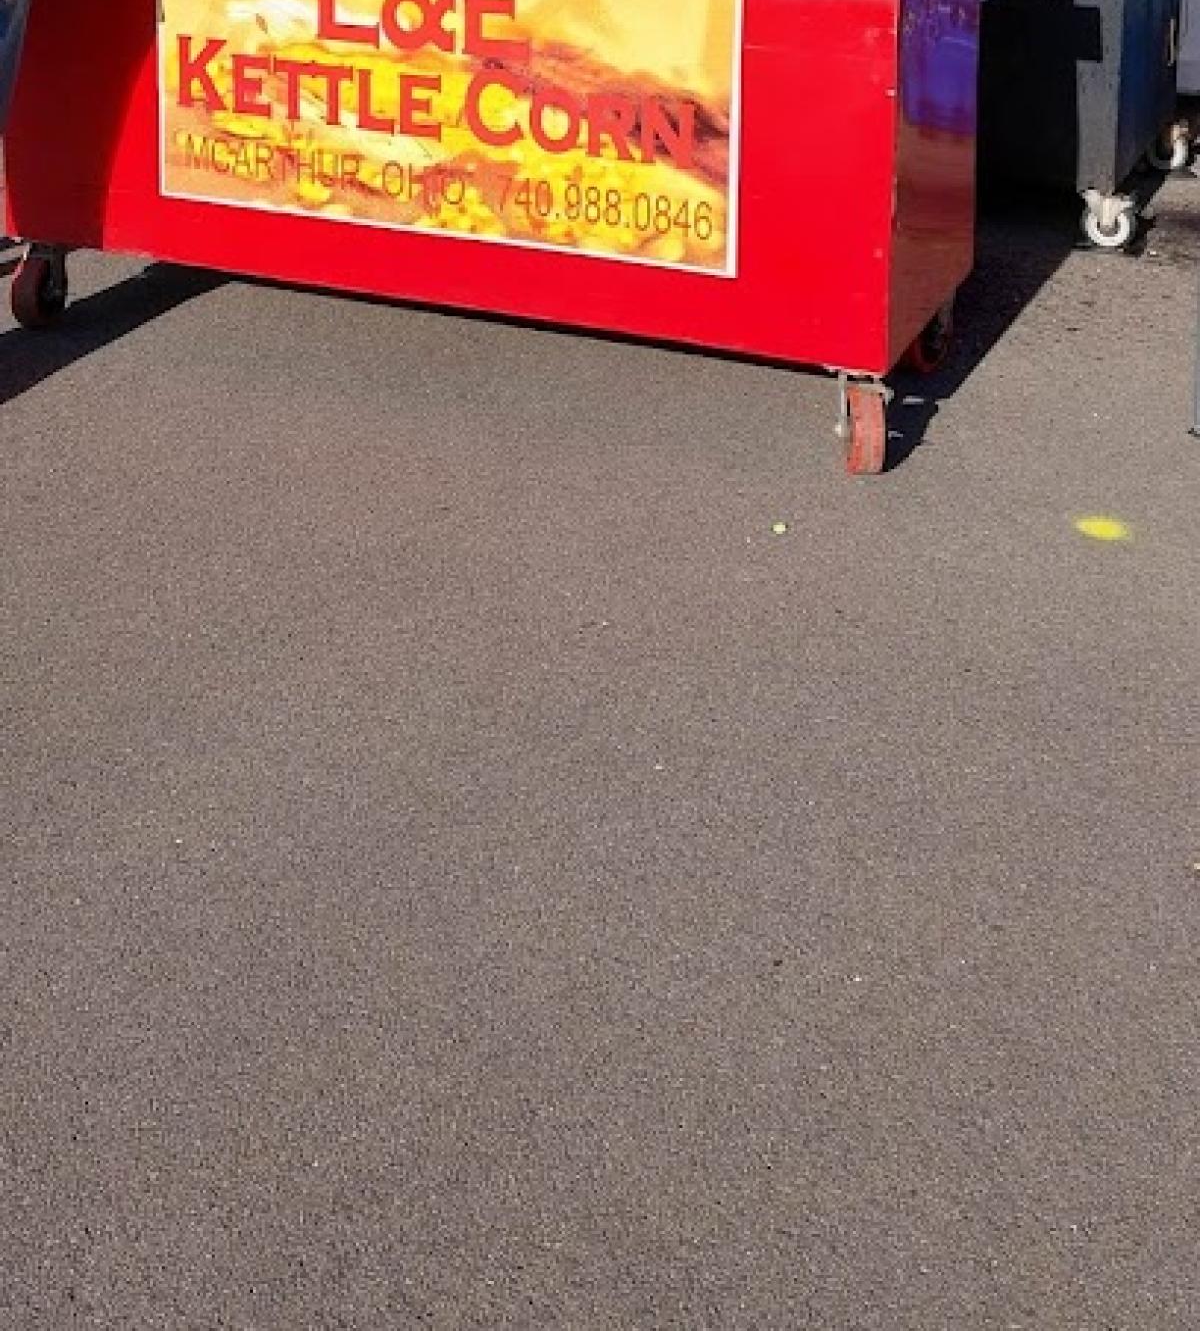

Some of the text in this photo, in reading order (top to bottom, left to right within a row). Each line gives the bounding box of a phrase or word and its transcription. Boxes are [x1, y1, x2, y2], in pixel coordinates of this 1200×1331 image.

[176, 34, 698, 165] KETTLE CORN
[497, 175, 713, 240] 740.988.0846
